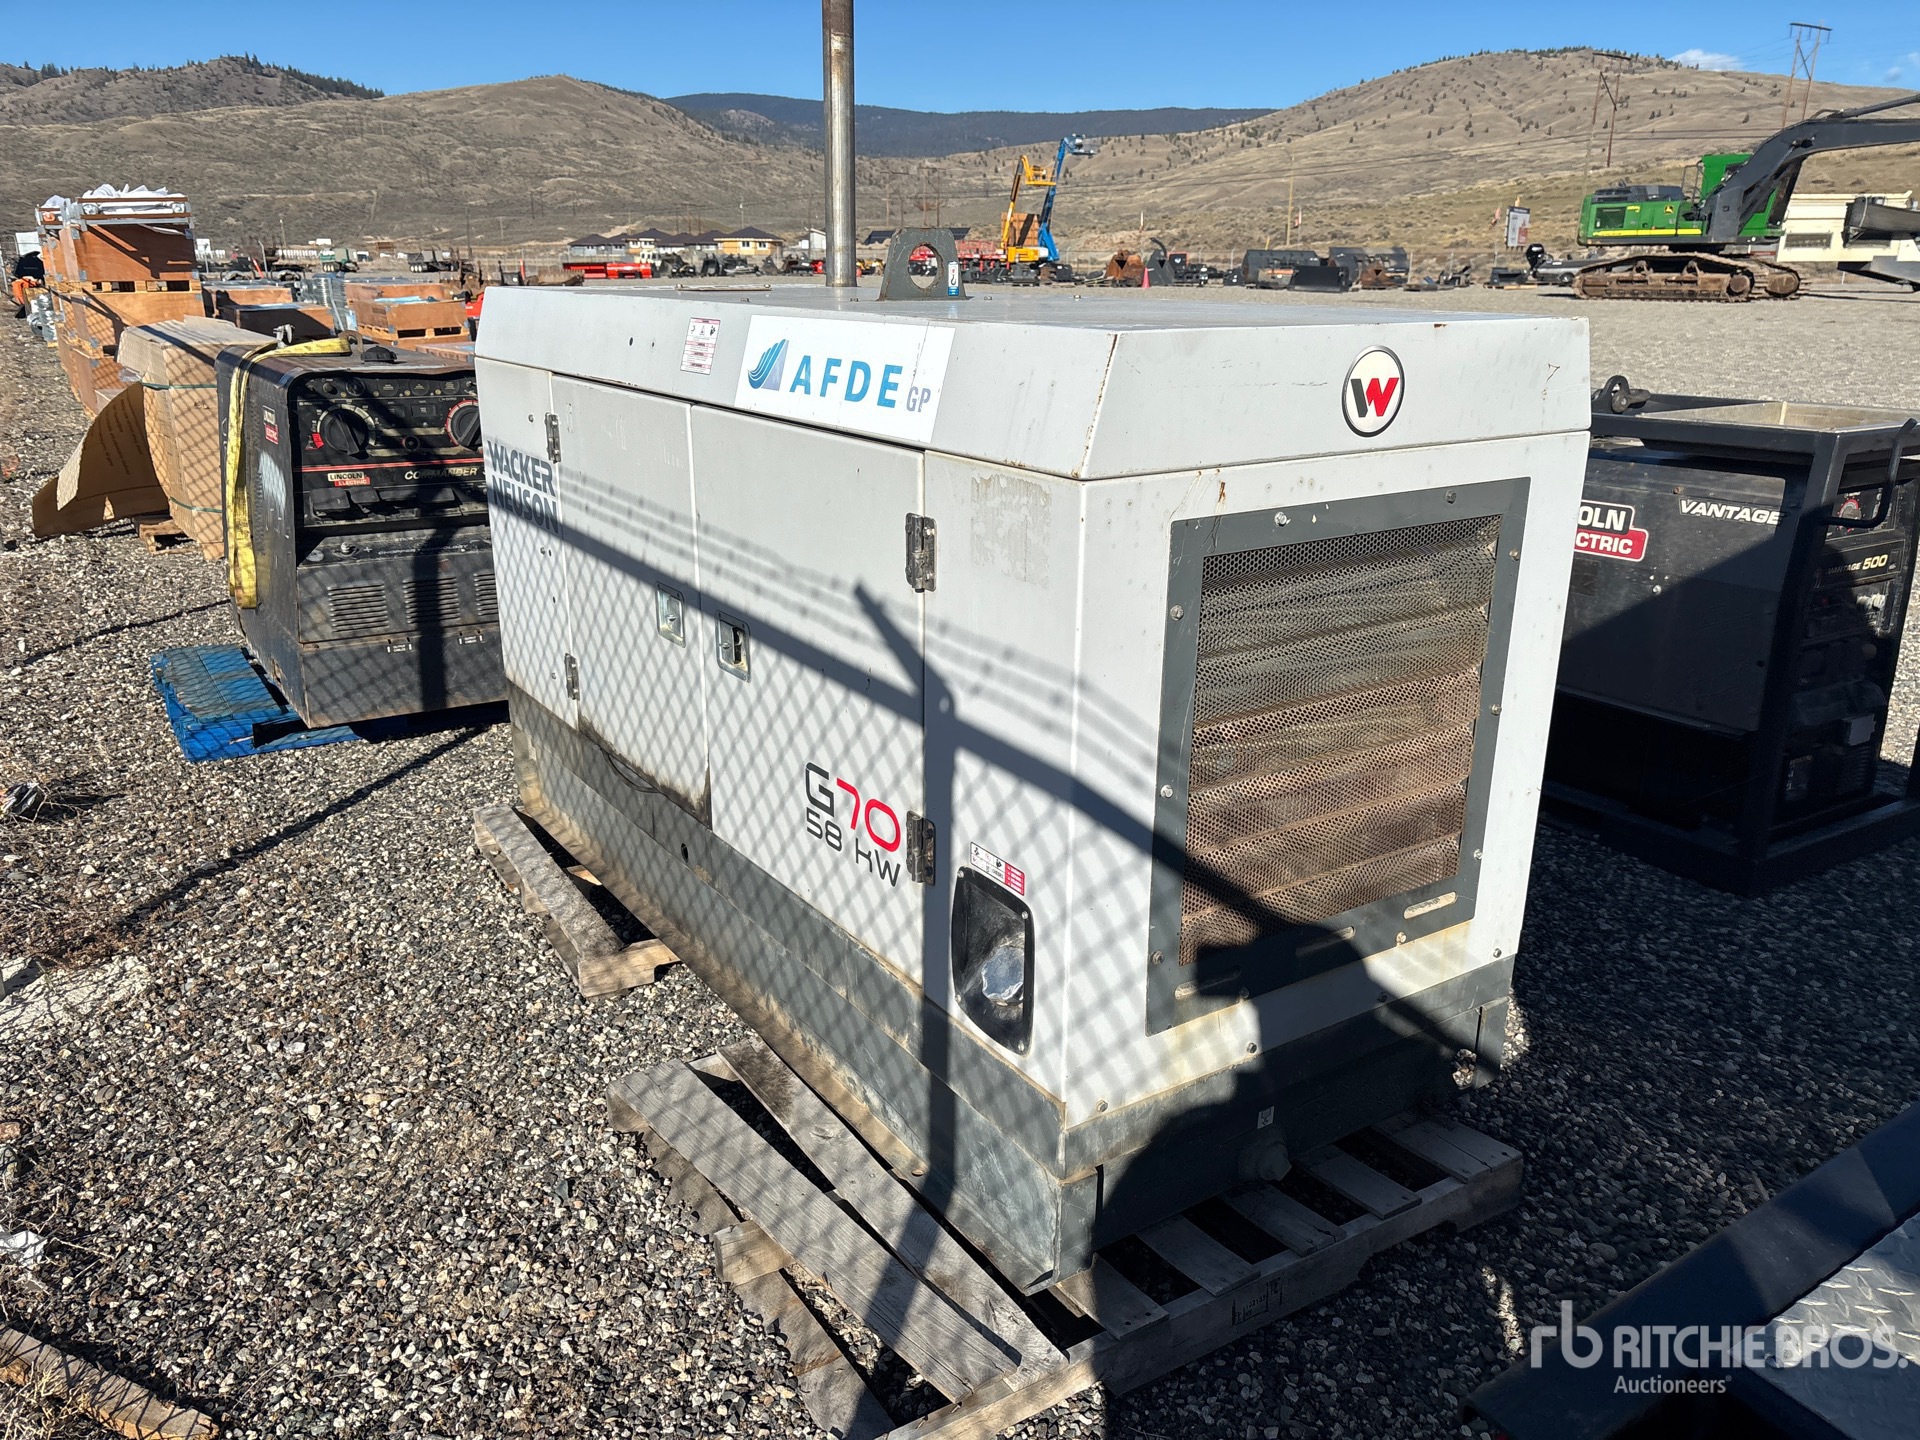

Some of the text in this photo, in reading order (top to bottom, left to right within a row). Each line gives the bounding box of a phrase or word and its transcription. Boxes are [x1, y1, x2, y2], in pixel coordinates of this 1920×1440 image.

[788, 354, 931, 414] AFDE GP
[1350, 377, 1400, 418] W
[329, 472, 364, 481] LINCOLN
[404, 466, 478, 480] COMMANDER
[487, 440, 556, 497] WACKER
[491, 474, 559, 534] NEUSON
[1679, 498, 1782, 526] VANTAGE
[1862, 554, 1889, 570] 500
[804, 762, 902, 853] G70
[805, 806, 843, 852] 58
